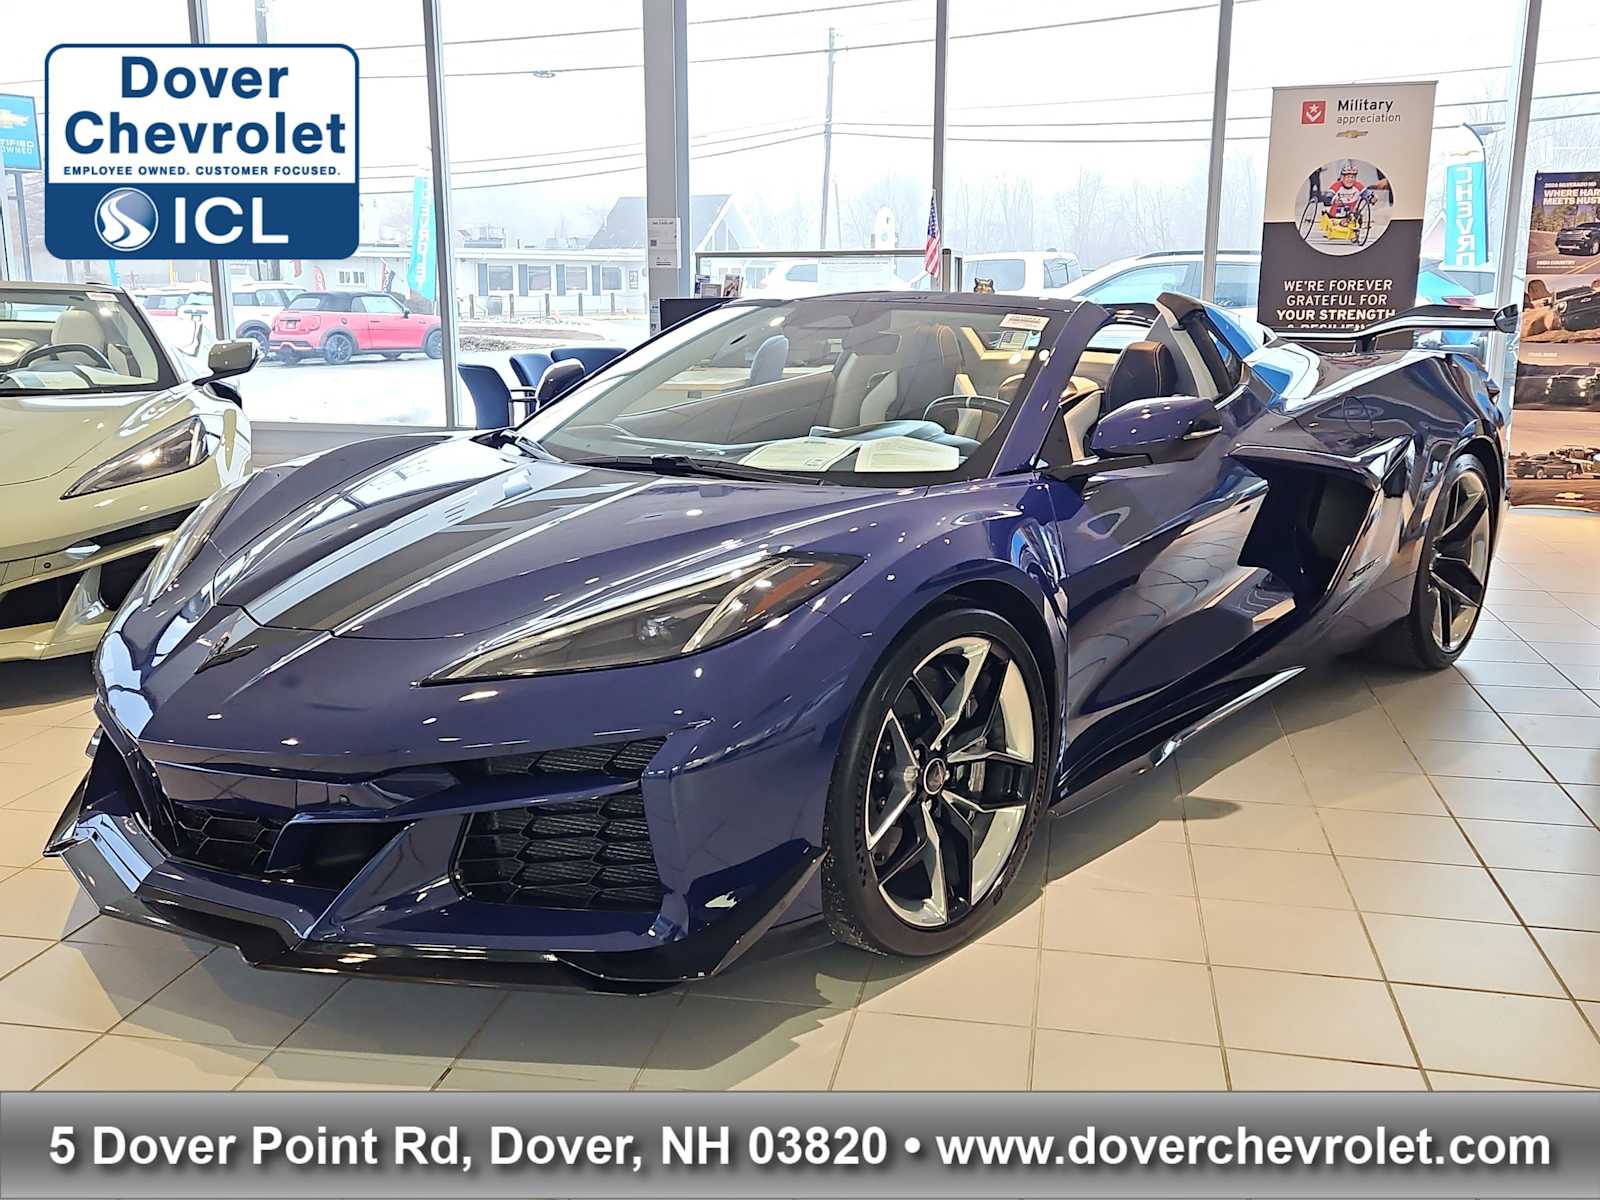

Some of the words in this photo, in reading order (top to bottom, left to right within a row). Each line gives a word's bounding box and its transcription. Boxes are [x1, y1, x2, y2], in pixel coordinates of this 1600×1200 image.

[1337, 99, 1394, 113] Military
[1336, 113, 1401, 126] appreciation
[1543, 189, 1579, 198] WHERE
[1543, 197, 1576, 206] MEETS
[1284, 280, 1325, 292] WE'RE
[1329, 279, 1393, 292] FOREVER
[1286, 295, 1356, 306] GRATEFUL
[1359, 294, 1388, 306] FOR
[1276, 309, 1315, 321] YOUR
[1319, 308, 1396, 321] STRENGTH
